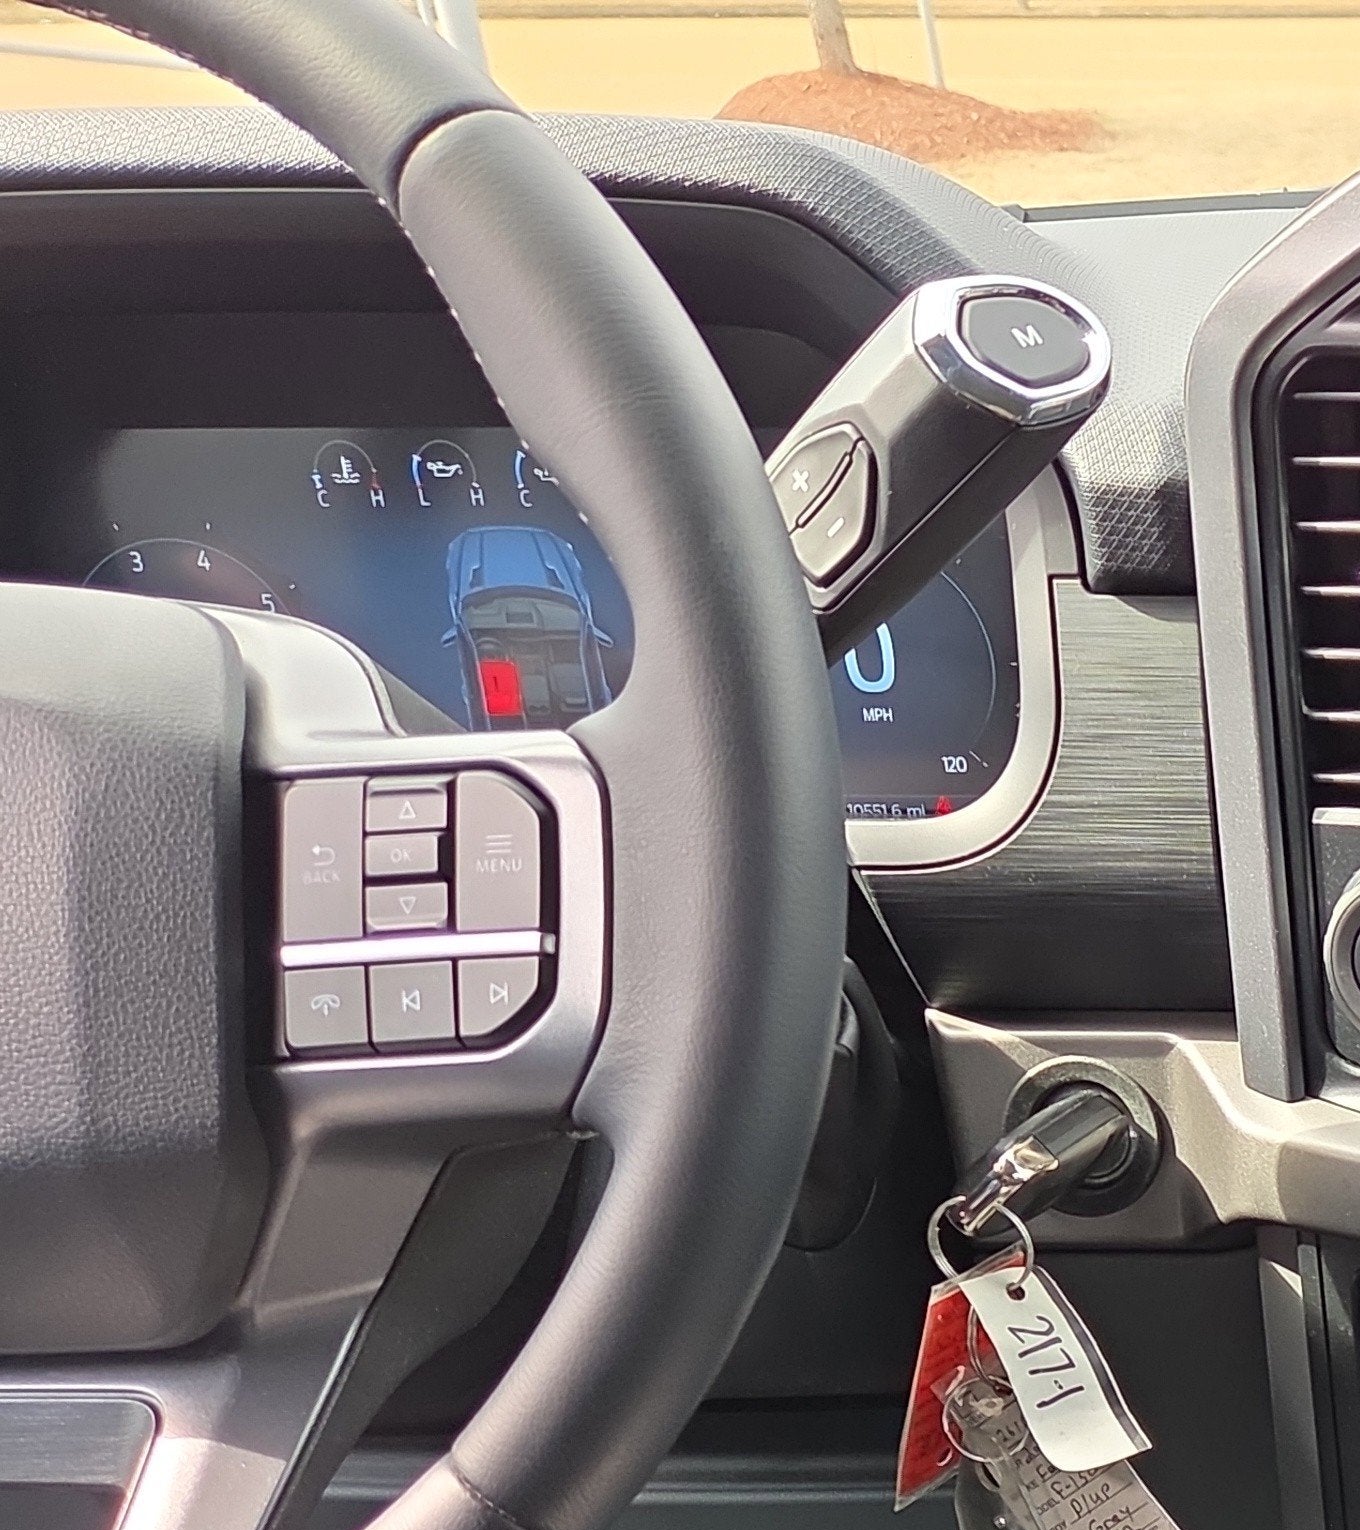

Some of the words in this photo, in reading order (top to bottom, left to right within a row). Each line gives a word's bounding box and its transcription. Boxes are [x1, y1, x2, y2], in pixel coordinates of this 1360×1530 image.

[1011, 323, 1044, 349] M
[129, 551, 144, 573] 3
[197, 550, 211, 572] 4
[862, 707, 894, 723] MPH
[940, 756, 968, 774] 120
[475, 857, 523, 873] MENU
